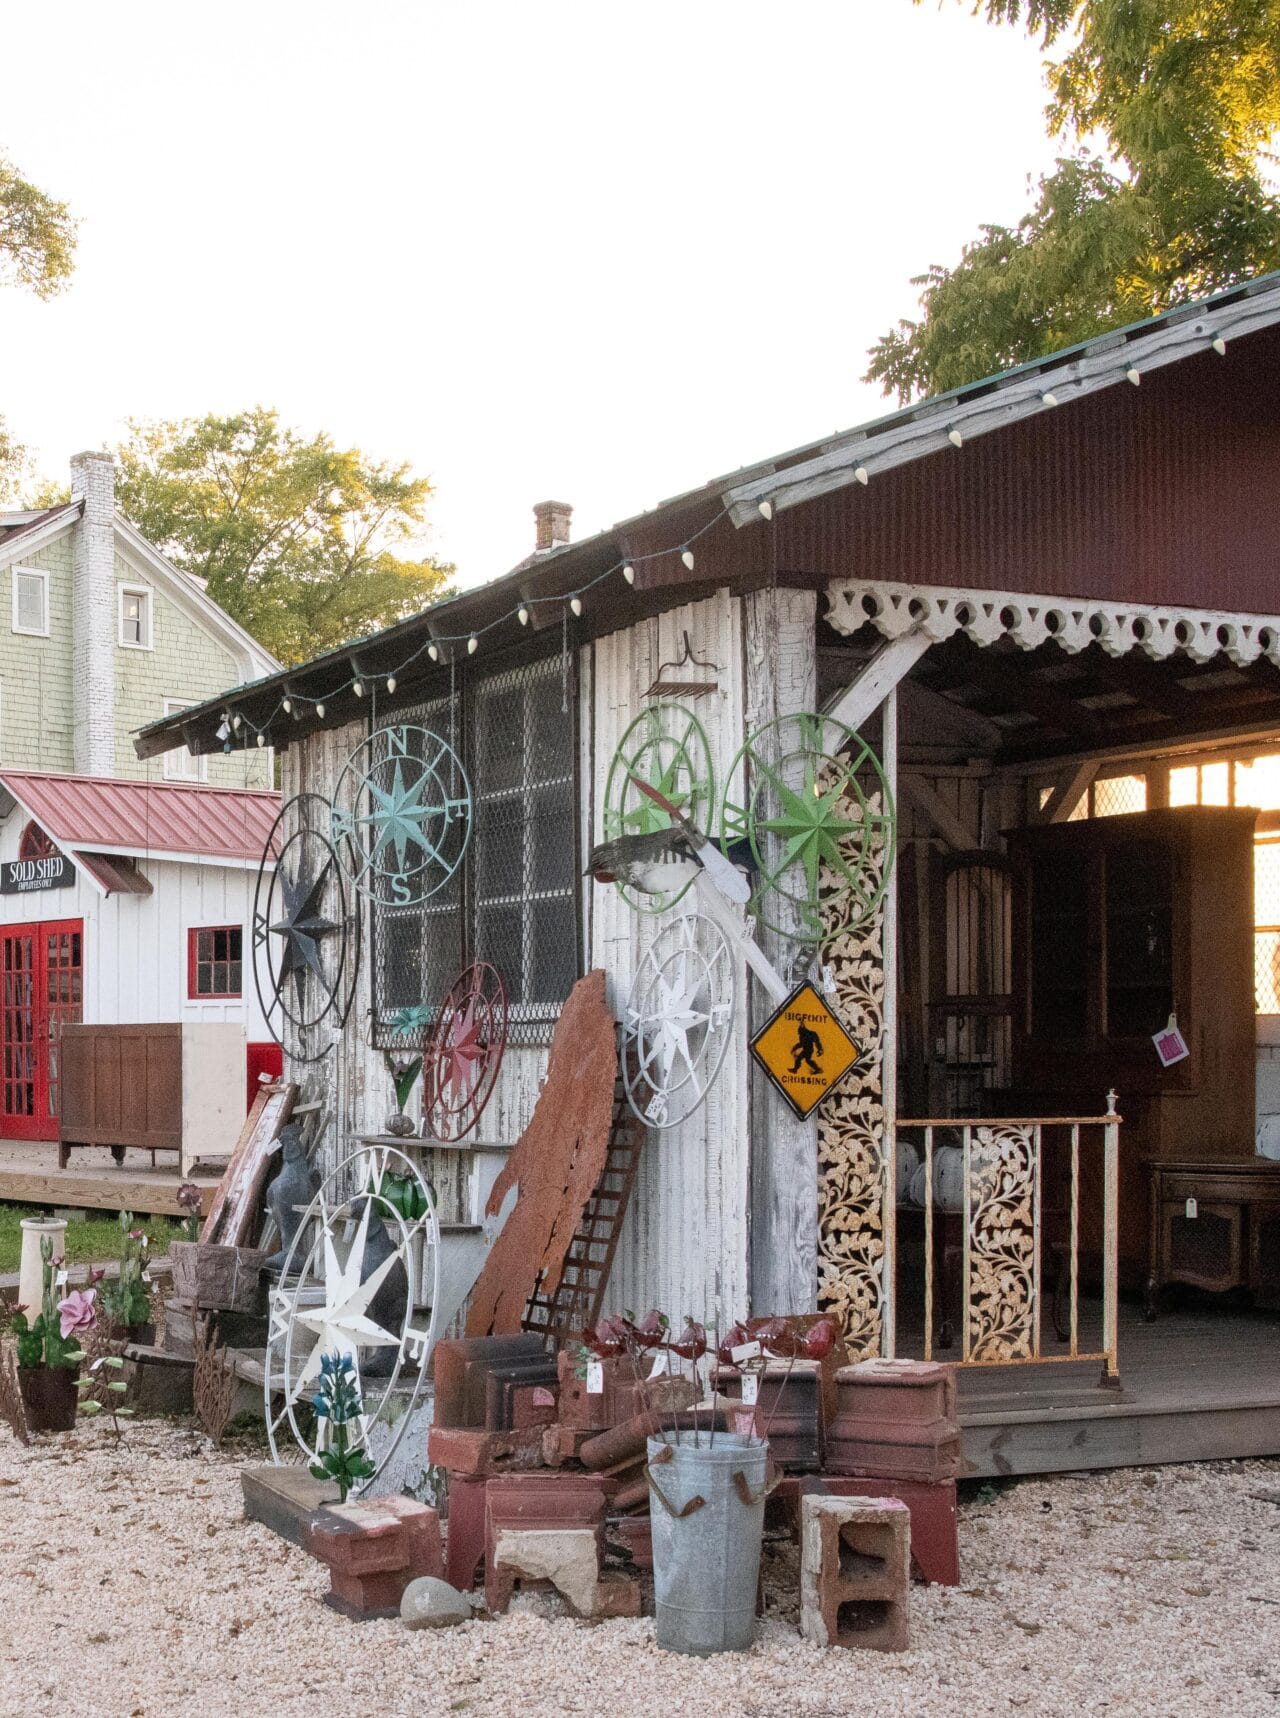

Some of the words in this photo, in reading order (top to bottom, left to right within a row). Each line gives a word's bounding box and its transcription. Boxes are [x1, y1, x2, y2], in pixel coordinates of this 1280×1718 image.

[387, 726, 407, 759] N
[722, 800, 752, 848] W
[10, 861, 35, 883] SOLD
[37, 857, 64, 879] SHED
[391, 874, 411, 906] S
[784, 1012, 829, 1024] BIGFOOT
[781, 1075, 828, 1086] CROSSING
